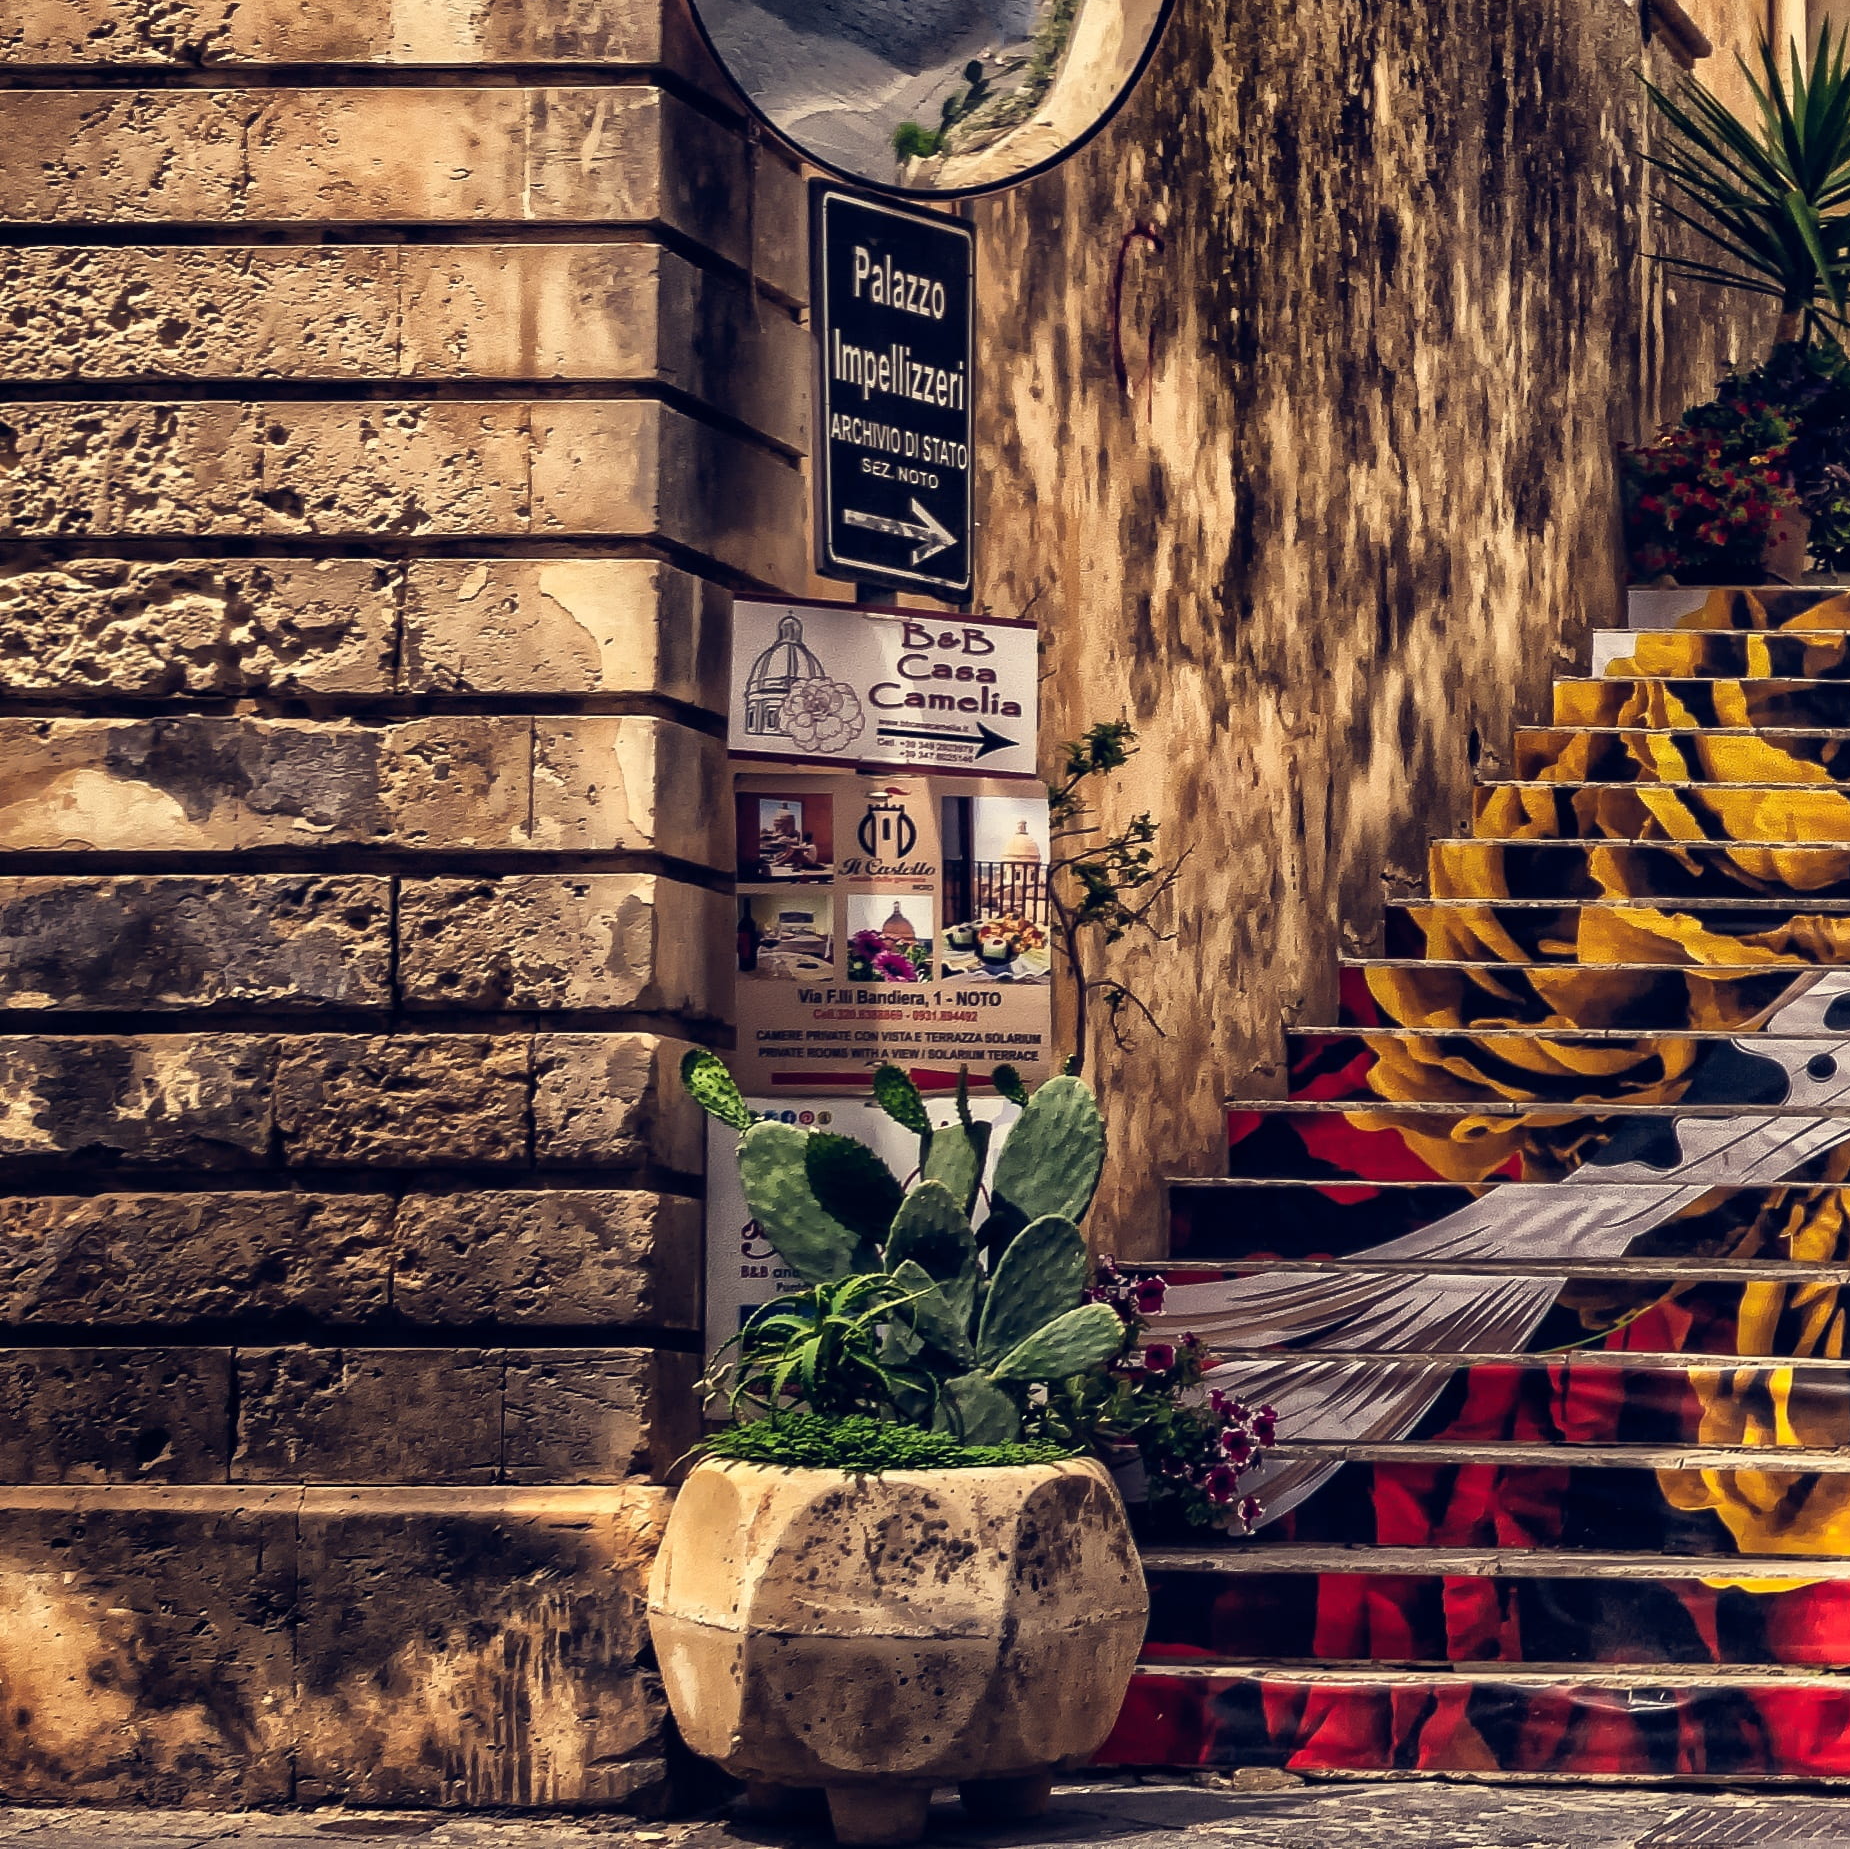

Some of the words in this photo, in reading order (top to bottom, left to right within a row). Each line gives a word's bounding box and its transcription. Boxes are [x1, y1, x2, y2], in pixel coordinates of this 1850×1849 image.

[853, 245, 945, 319] Palazzo
[833, 328, 964, 410] Impellizzeri
[831, 413, 901, 454] ARCHIVIO
[904, 431, 919, 459] DI
[922, 435, 968, 470] STATO
[897, 465, 939, 488] NOTO
[901, 621, 995, 656] B&B
[897, 653, 997, 684] Casa
[868, 682, 1022, 718] Camelia
[865, 858, 936, 876] Castello
[799, 988, 822, 1004] Via
[857, 989, 930, 1008] Bandiera,
[933, 990, 942, 1006] 1
[956, 991, 1002, 1007] NOTO
[756, 1030, 804, 1041] CAMERE
[806, 1030, 852, 1041] PRIVATE
[854, 1031, 879, 1042] CON
[881, 1031, 913, 1042] VISTA
[914, 1032, 922, 1042] E
[924, 1032, 983, 1043] TERRAZZA
[985, 1033, 1042, 1044] SOLARIUM
[758, 1048, 804, 1058] PRIVATE
[806, 1048, 849, 1058] ROOMS
[850, 1048, 880, 1059] WITH
[880, 1049, 890, 1059] A
[891, 1049, 919, 1059] VIEW
[928, 1049, 985, 1060] SOLARIUM
[987, 1050, 1040, 1061] TERRACE
[741, 1265, 769, 1278] B&B
